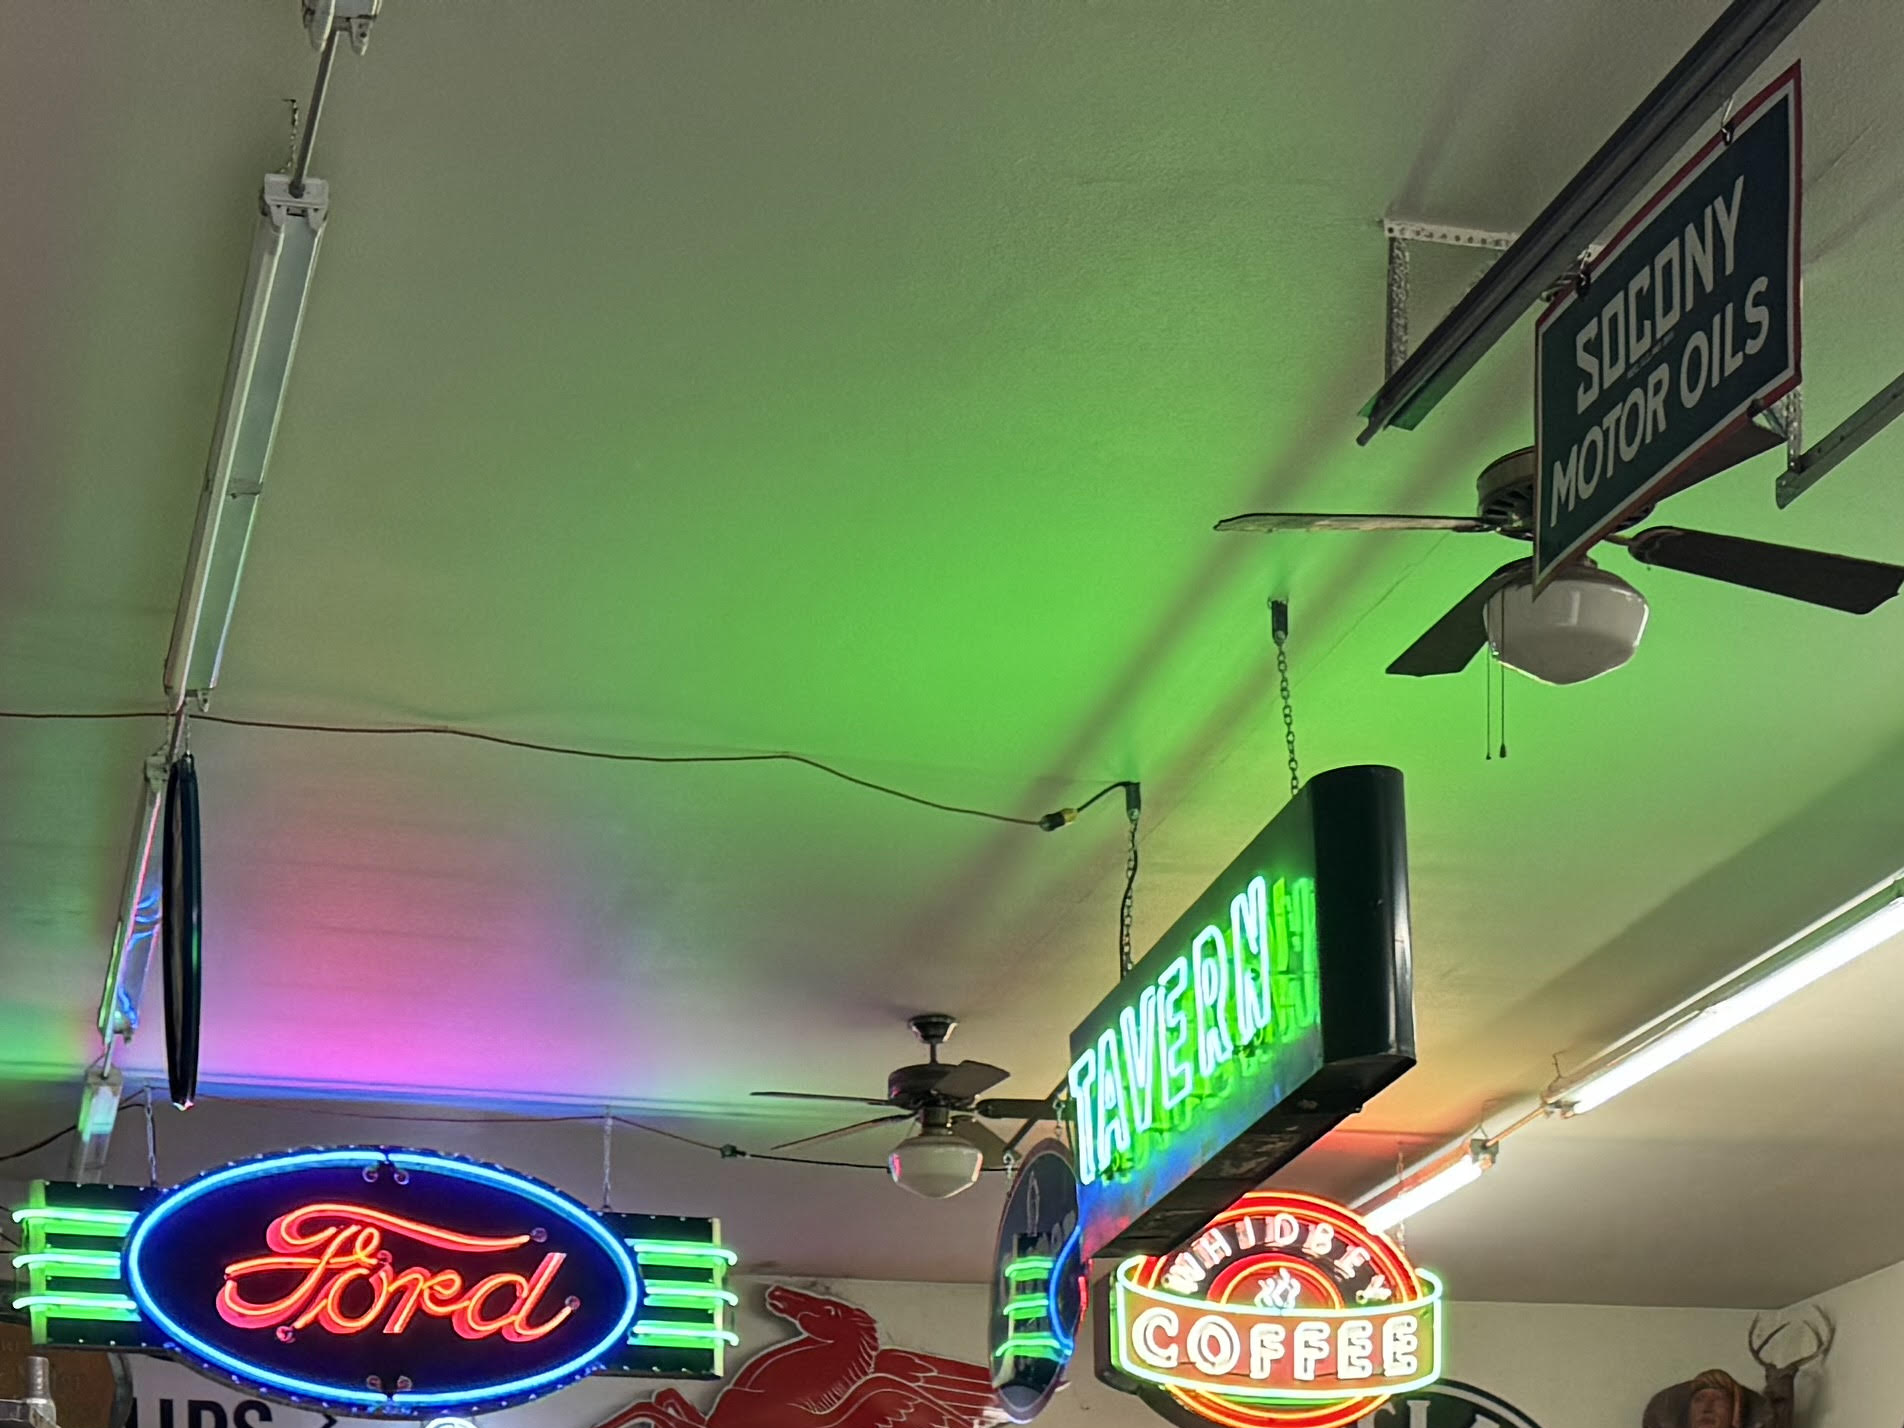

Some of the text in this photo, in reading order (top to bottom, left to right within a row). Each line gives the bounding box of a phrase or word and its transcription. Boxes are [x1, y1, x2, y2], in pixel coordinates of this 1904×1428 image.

[1576, 176, 1744, 414] SOCONY
[1552, 276, 1771, 530] MOTOR OILS
[1068, 877, 1286, 1185] TAVERN
[216, 1203, 580, 1342] Ford
[1133, 1308, 1417, 1380] COFFEE
[1163, 1213, 1392, 1303] WHIDBEY
